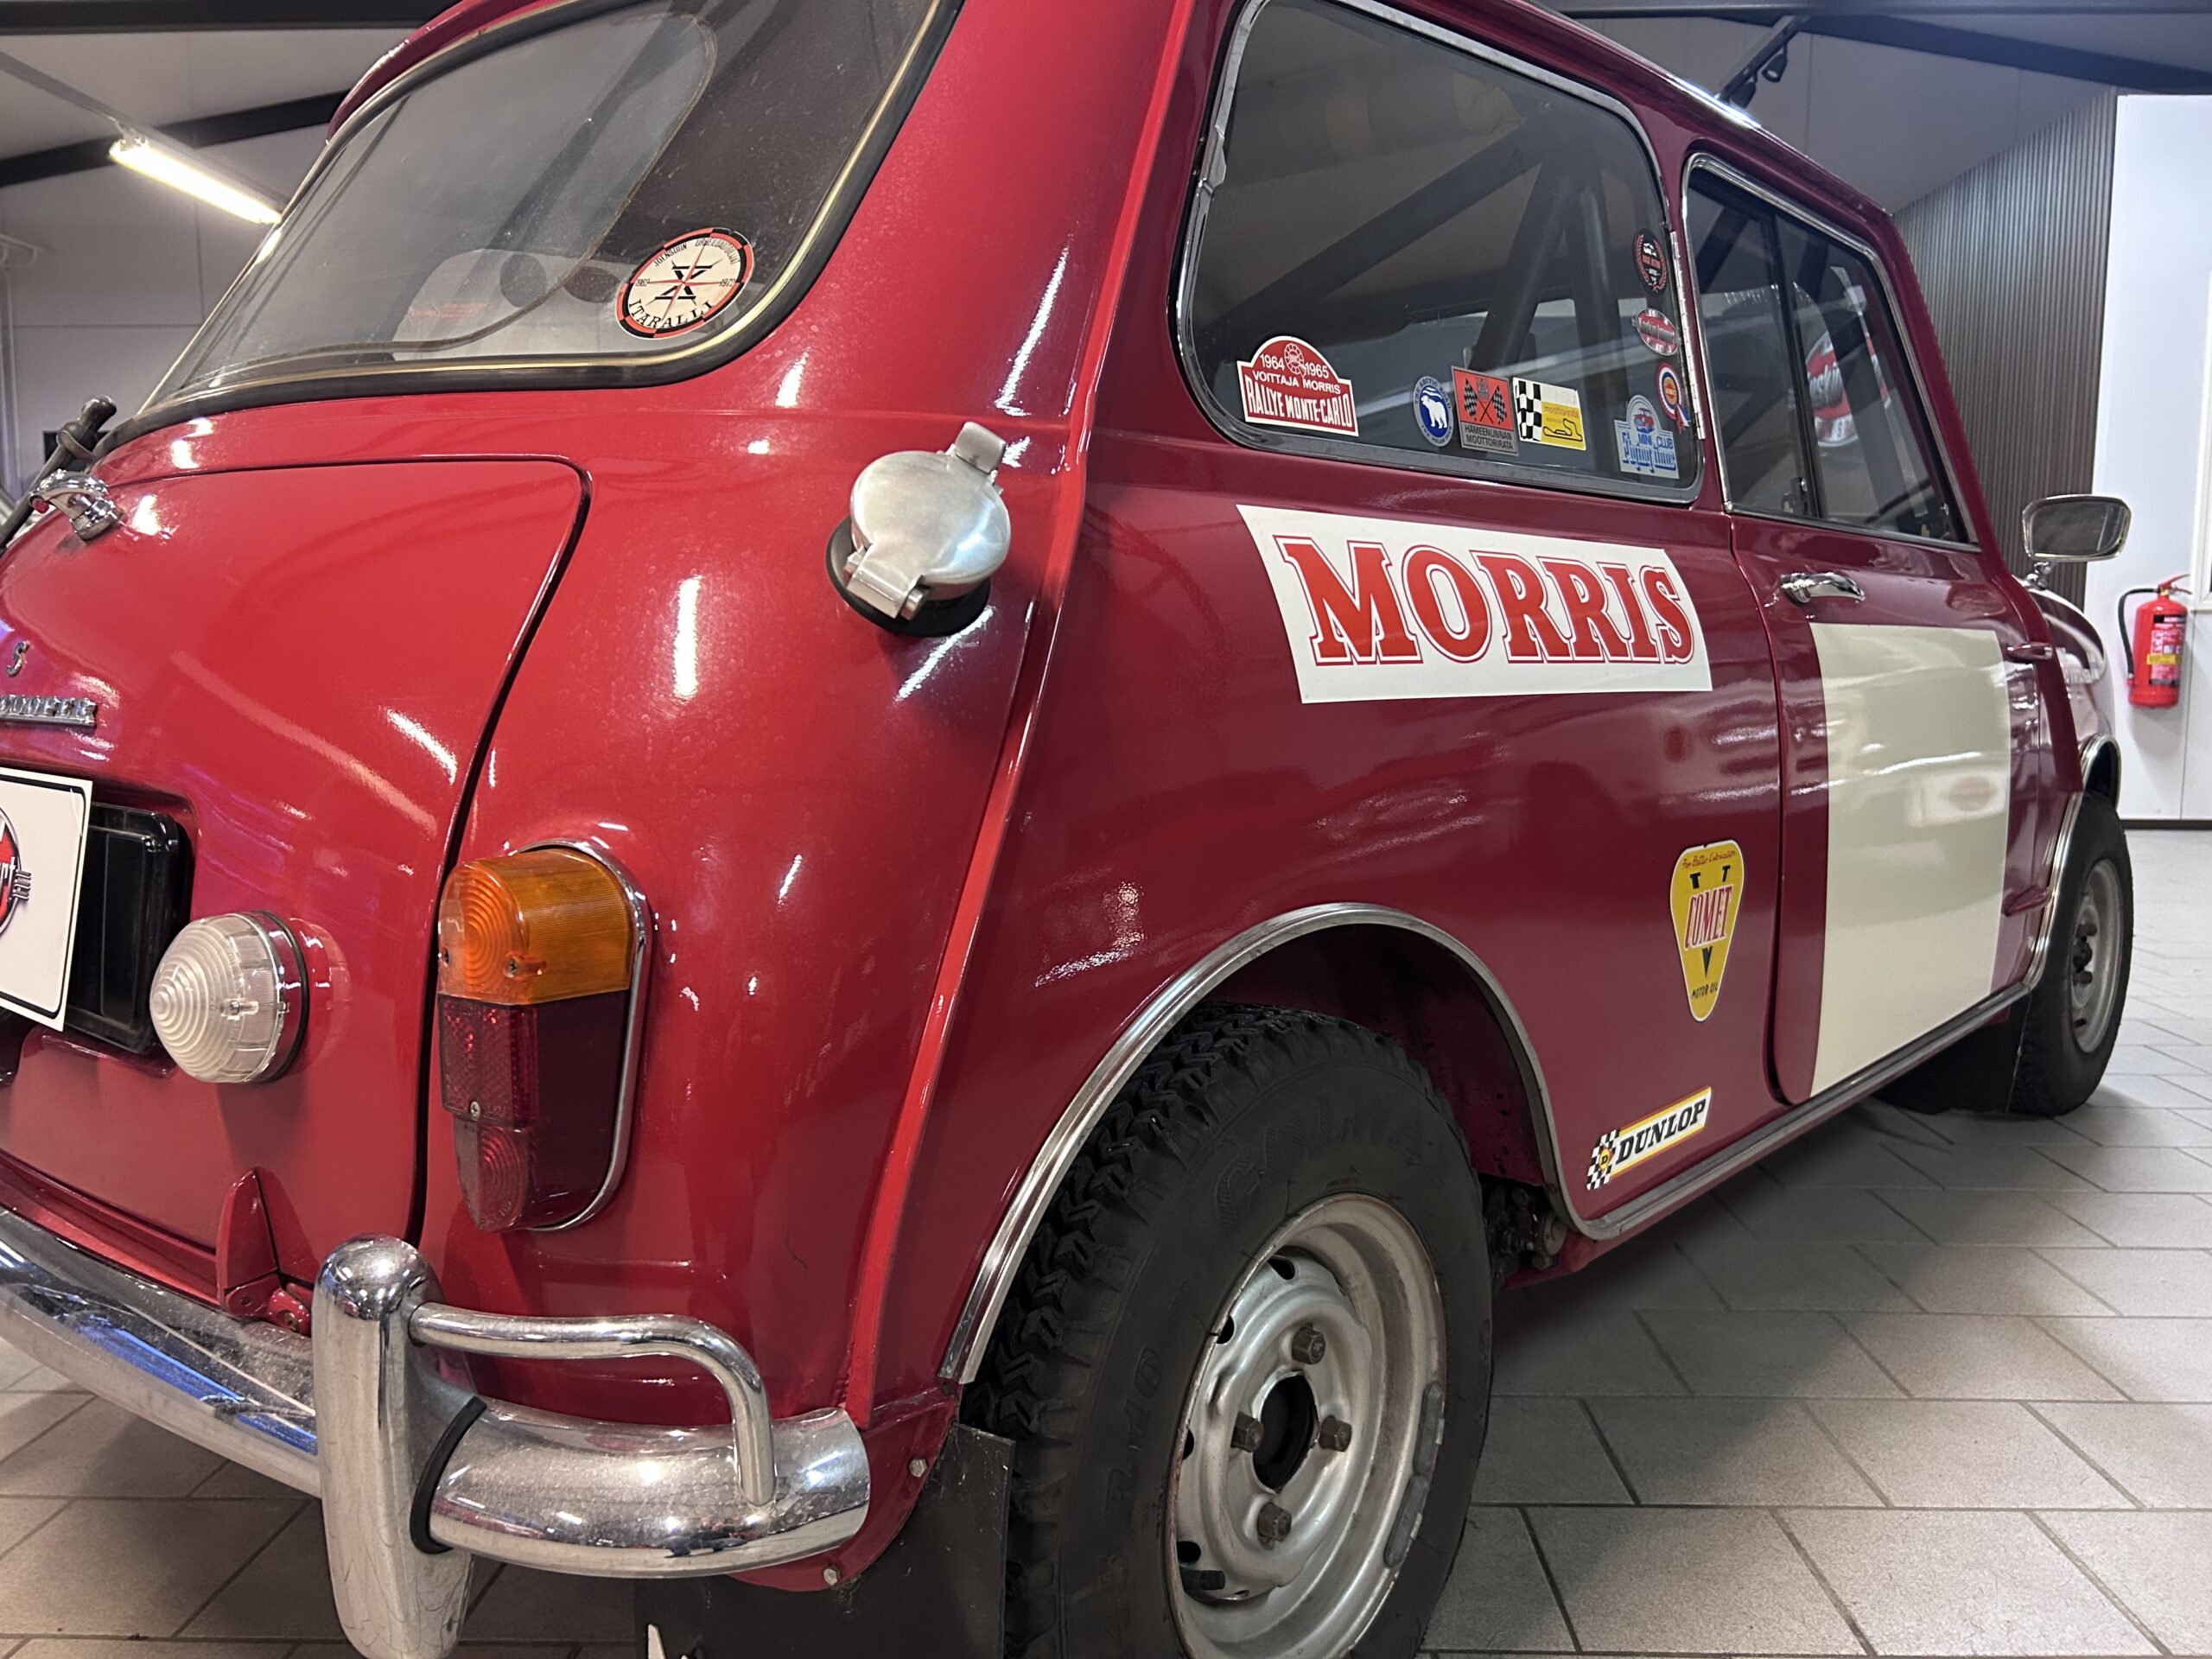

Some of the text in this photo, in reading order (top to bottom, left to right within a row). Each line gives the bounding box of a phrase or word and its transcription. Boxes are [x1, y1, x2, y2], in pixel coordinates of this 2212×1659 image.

[1260, 354, 1286, 372] 1964
[1305, 362, 1330, 379] 1965
[1252, 370, 1341, 395] VOITTAJA MORRIS
[1245, 375, 1353, 428] RALLYE MONTE-CARLO
[1656, 435, 1674, 449] CLUB
[1273, 534, 1695, 666] MORRIS
[1684, 885, 1733, 950] COMET
[1691, 982, 1719, 1001] MOTOR OIL
[1616, 1098, 1707, 1166] DUNLOP
